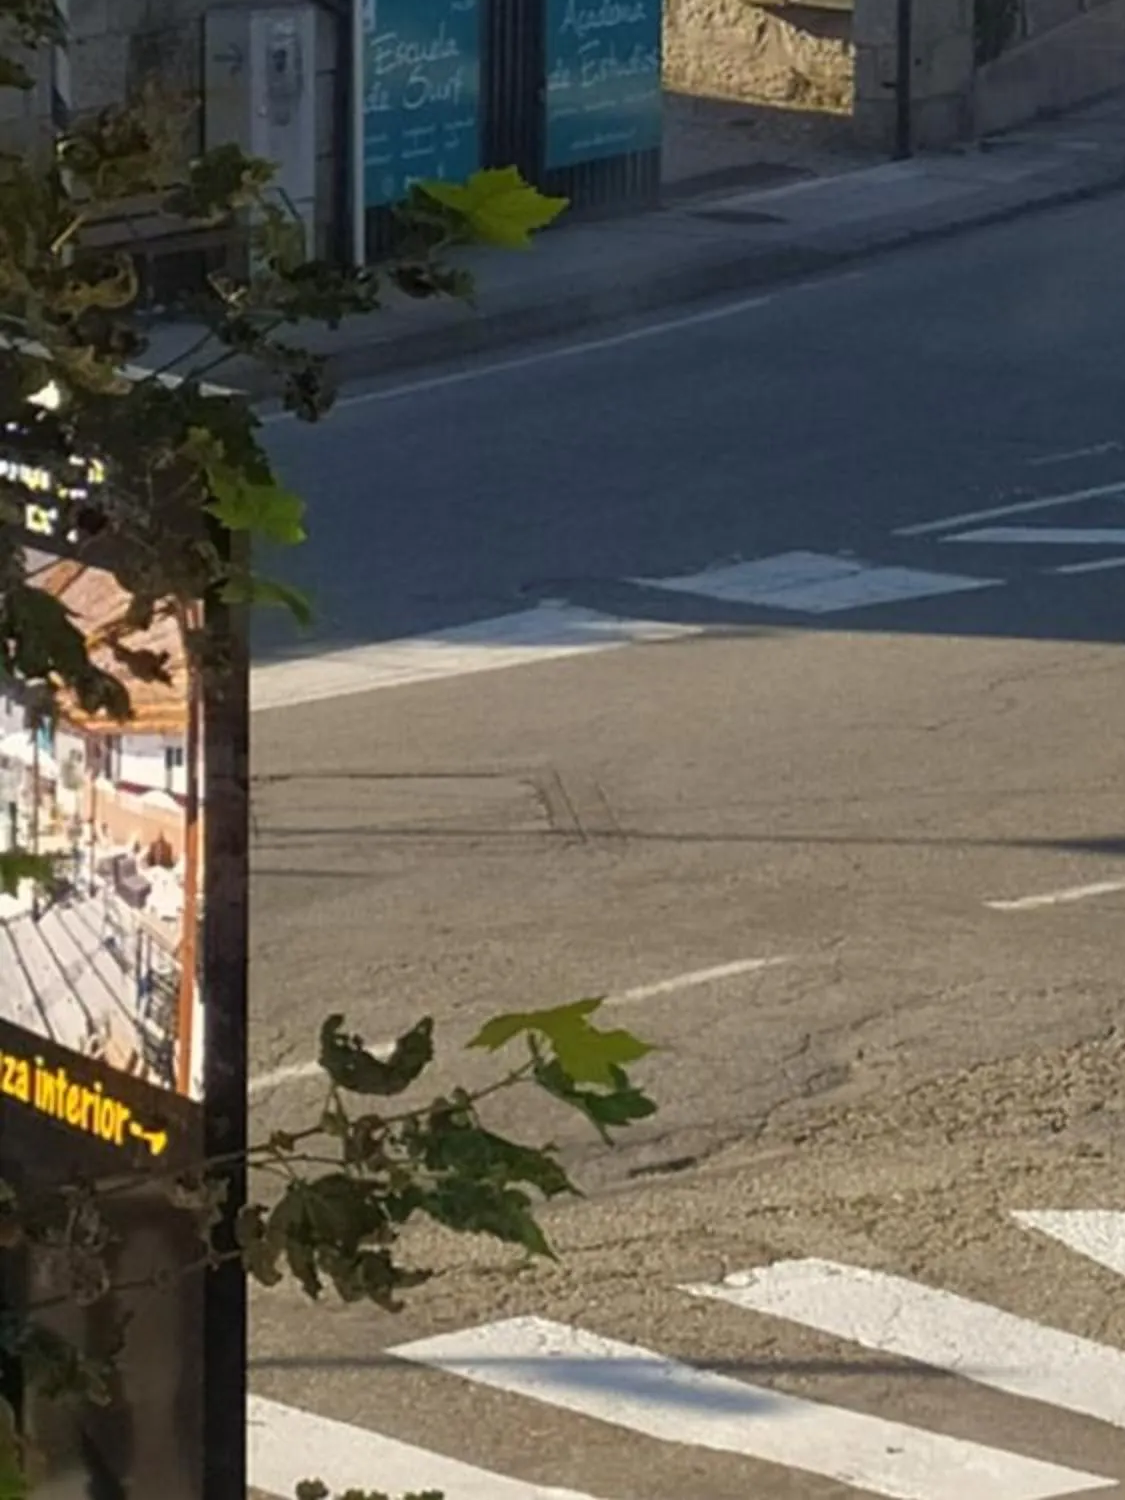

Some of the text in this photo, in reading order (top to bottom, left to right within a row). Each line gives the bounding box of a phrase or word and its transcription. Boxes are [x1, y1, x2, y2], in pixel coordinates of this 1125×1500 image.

[403, 65, 464, 109] Surf
[0, 1052, 130, 1145] za interior
